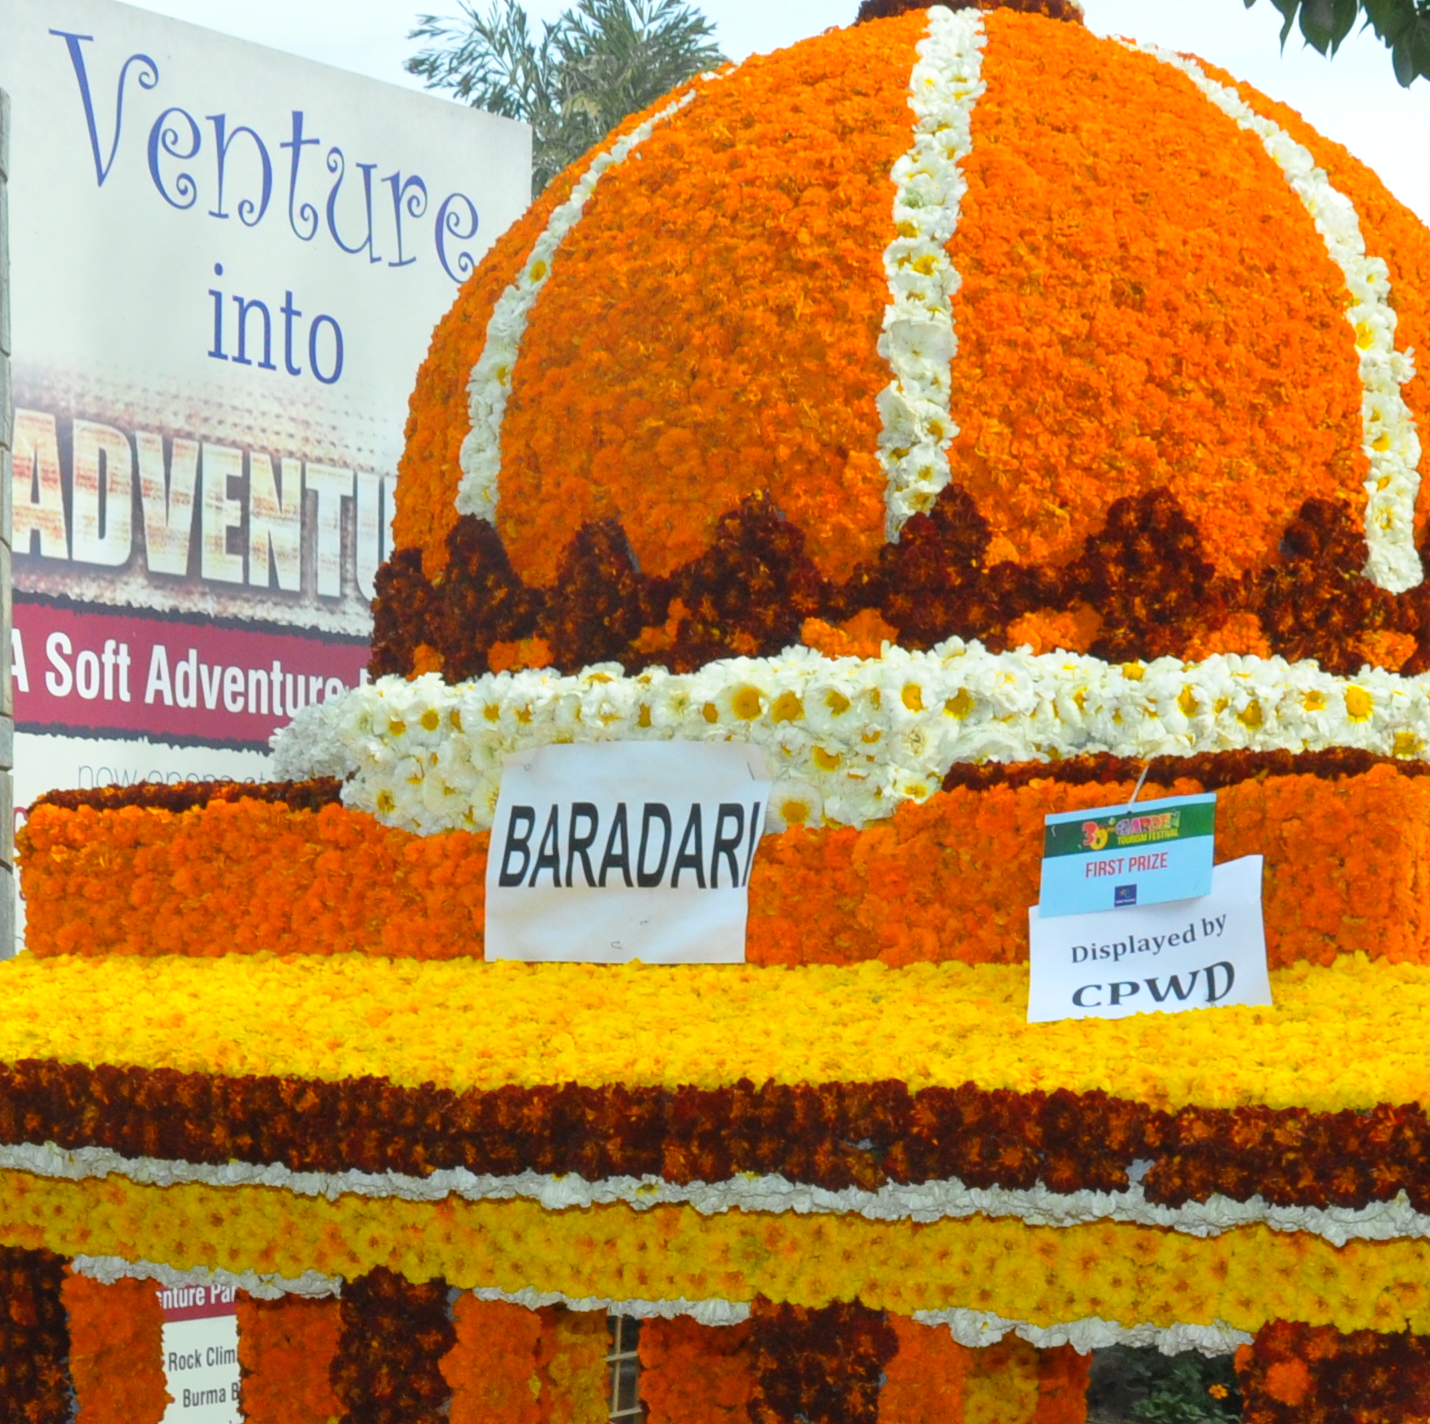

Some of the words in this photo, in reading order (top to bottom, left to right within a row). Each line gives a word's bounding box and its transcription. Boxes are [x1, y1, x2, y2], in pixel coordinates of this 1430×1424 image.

[48, 28, 479, 284] Venture
[208, 262, 344, 385] into
[45, 632, 132, 702] Soft
[144, 644, 346, 717] Adventure
[498, 801, 761, 889] BARADARI
[1085, 857, 1125, 879] FIRST
[1128, 851, 1169, 873] PRIZE
[1071, 923, 1197, 964] Displayed
[1202, 913, 1227, 938] by
[1071, 960, 1235, 1008] CPWD
[168, 1348, 202, 1372] Rock
[183, 1387, 227, 1408] Burma
